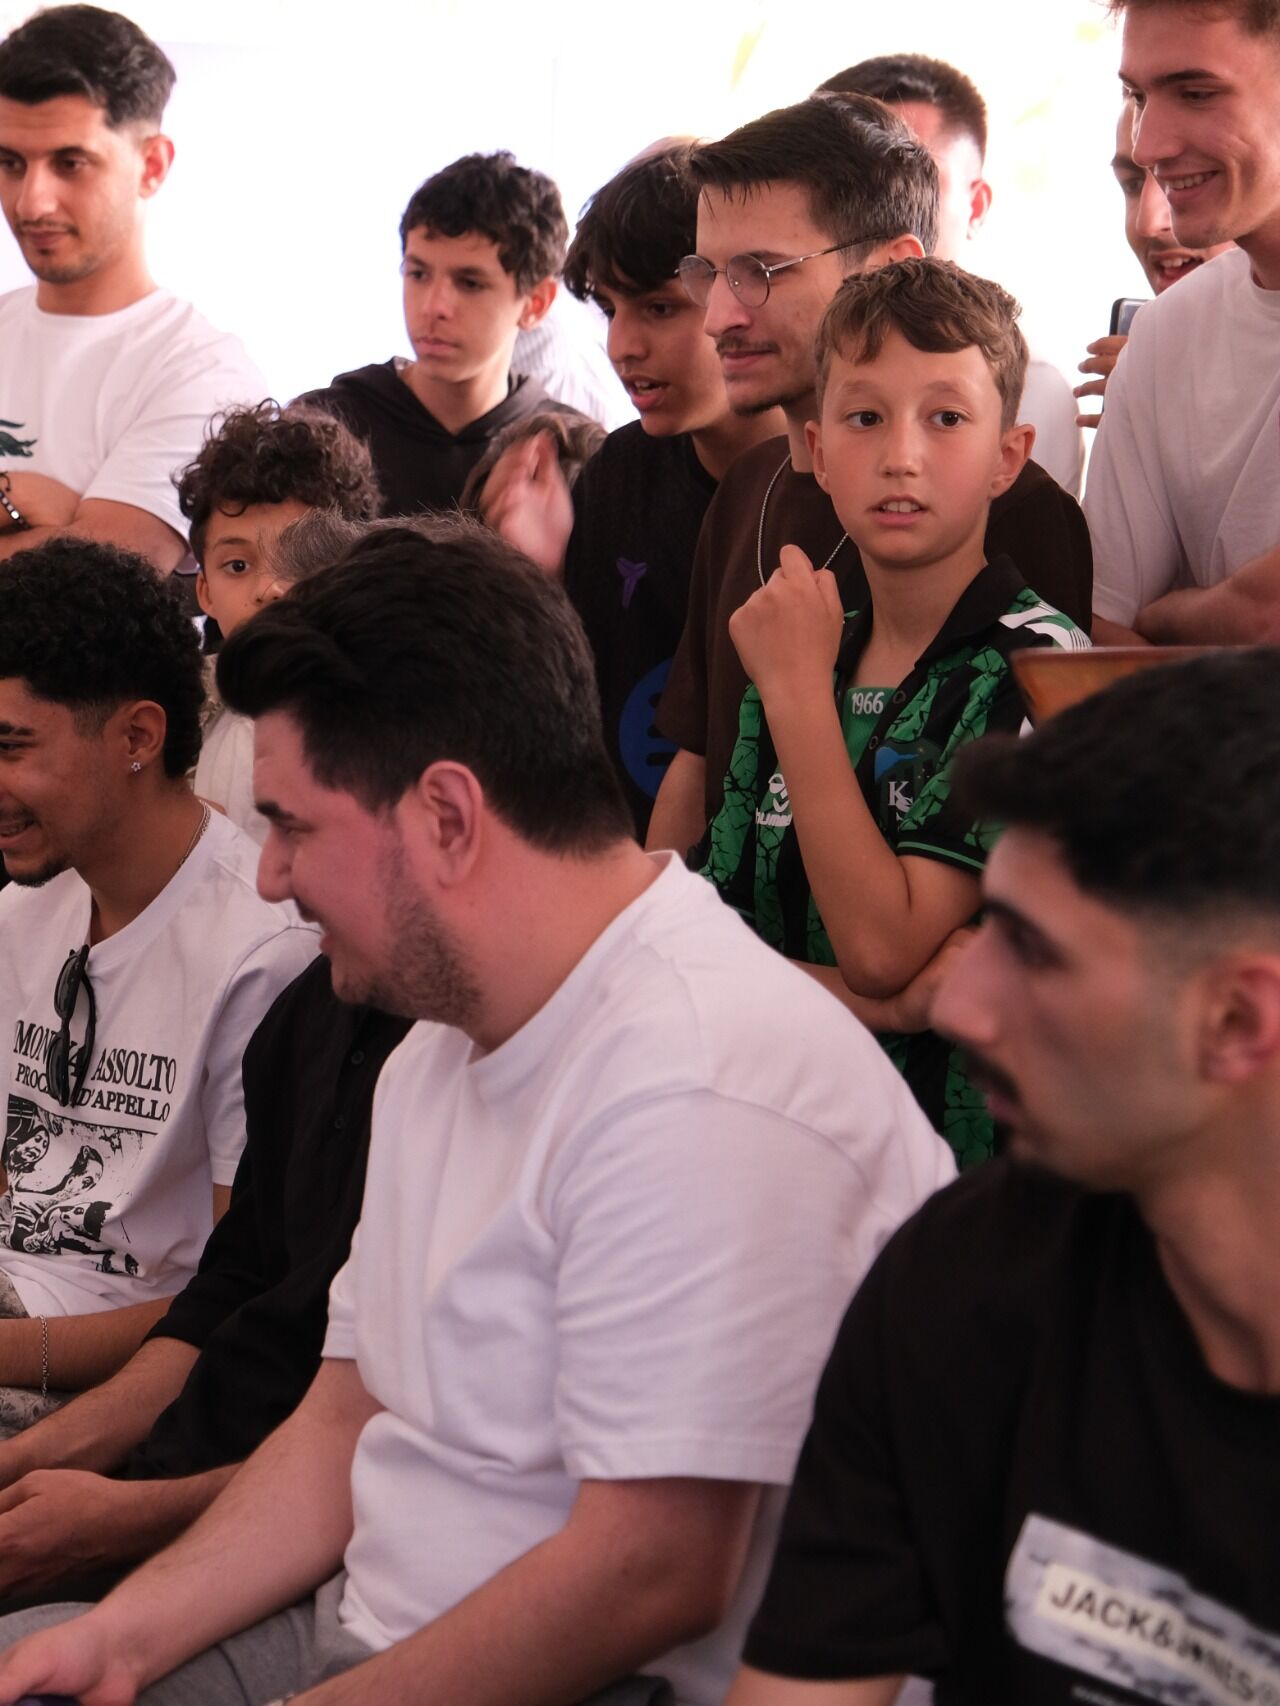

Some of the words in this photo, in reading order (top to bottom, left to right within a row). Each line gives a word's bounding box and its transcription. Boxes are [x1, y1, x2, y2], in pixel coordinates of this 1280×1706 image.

[851, 692, 885, 715] 1966
[91, 1048, 176, 1094] ASSOLTO
[78, 1087, 170, 1122] D'APPELLO
